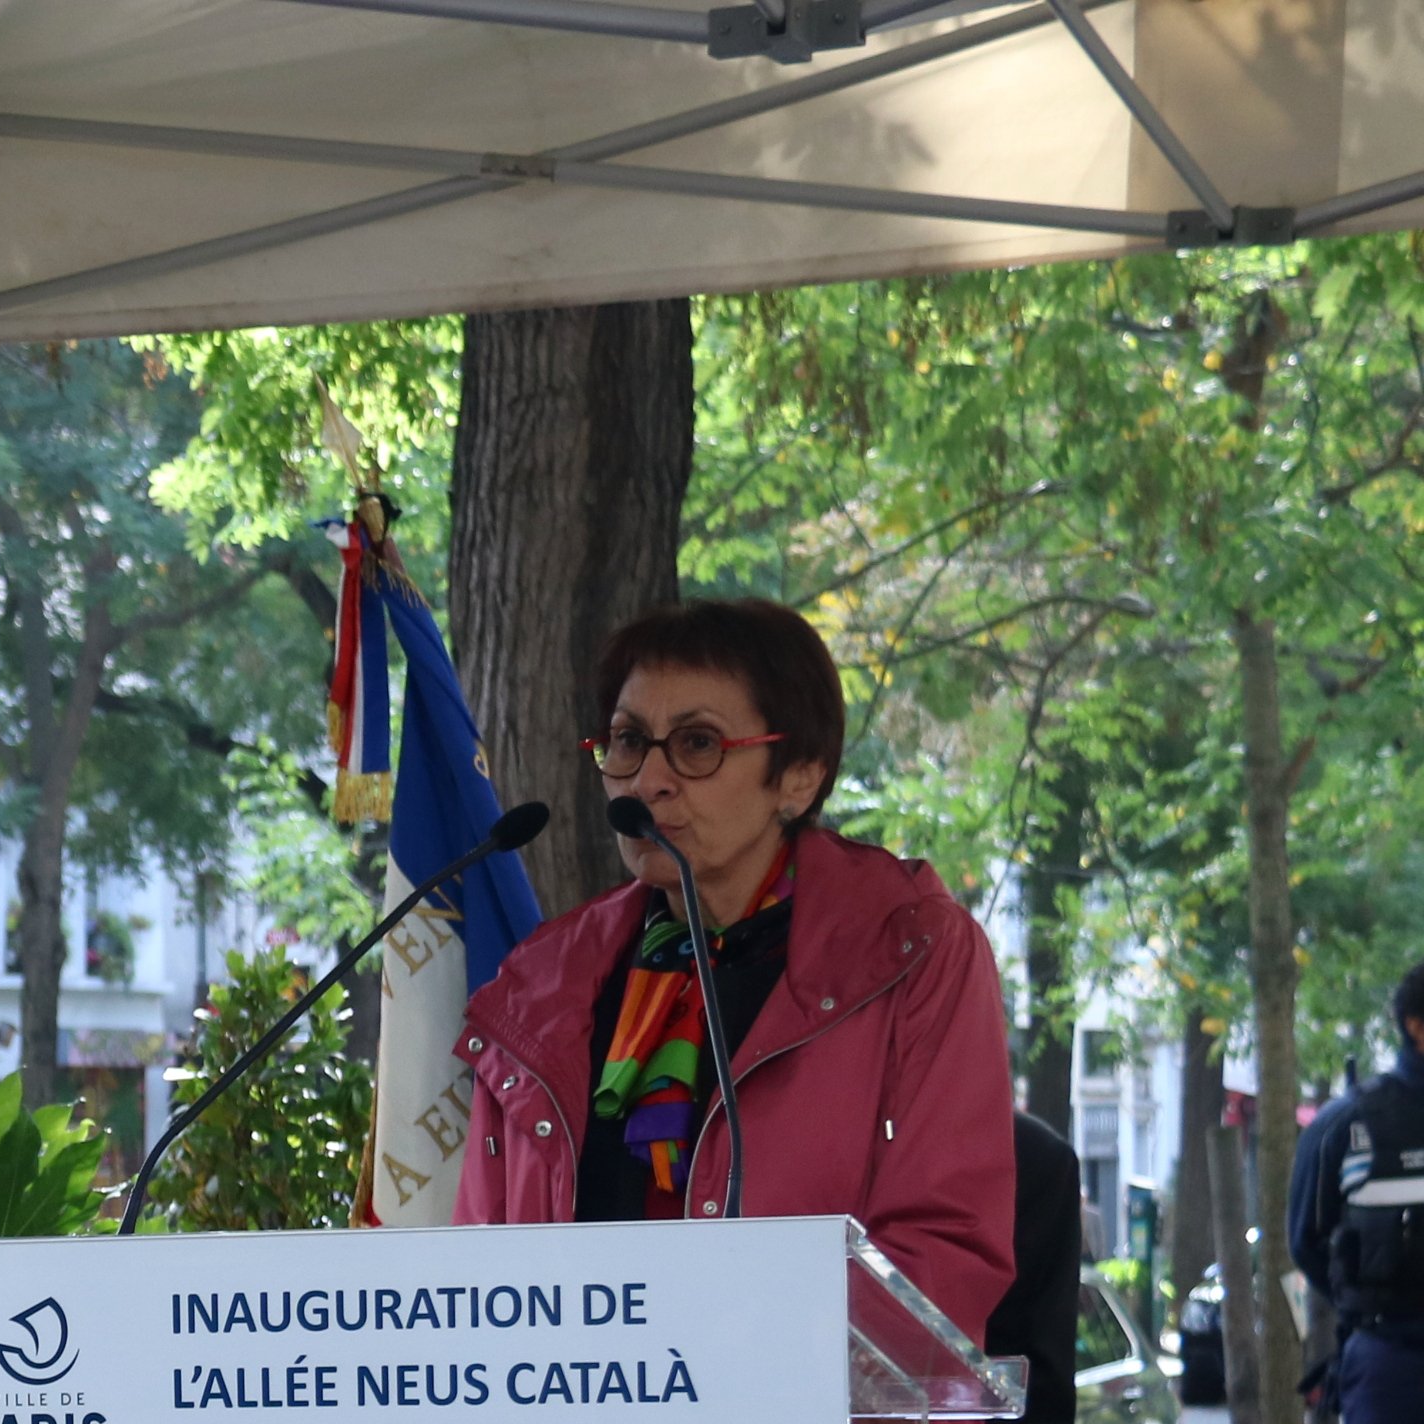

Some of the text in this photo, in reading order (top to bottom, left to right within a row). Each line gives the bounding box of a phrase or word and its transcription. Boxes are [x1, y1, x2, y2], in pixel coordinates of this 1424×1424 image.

[172, 1281, 648, 1336] INAUGURATION DE
[59, 1391, 86, 1408] DE
[355, 1361, 491, 1407] NEUS
[505, 1346, 700, 1405] CATALÀ
